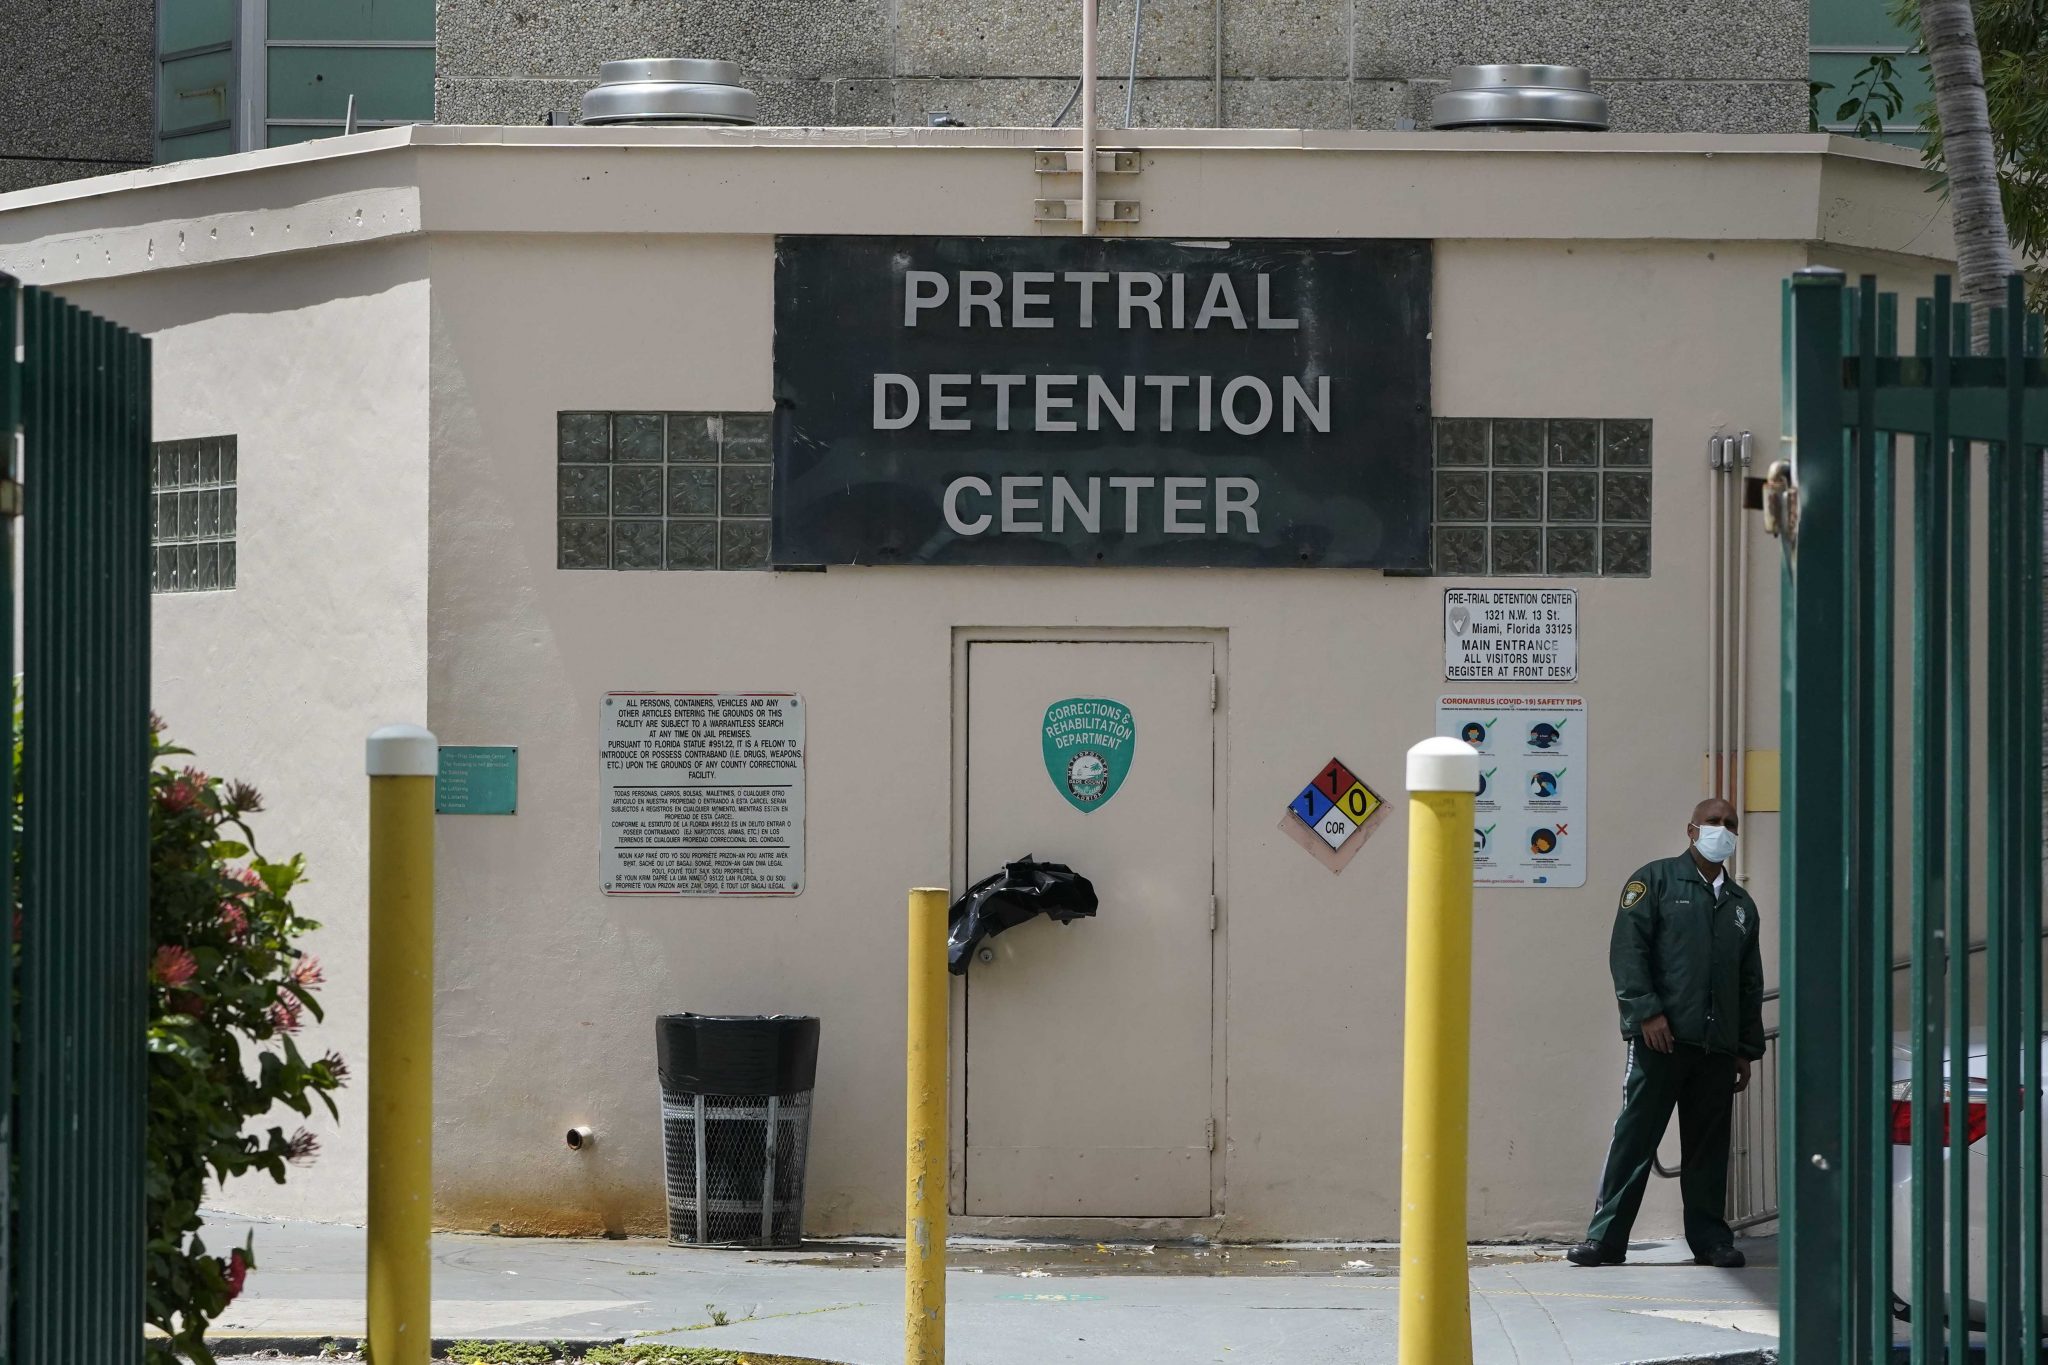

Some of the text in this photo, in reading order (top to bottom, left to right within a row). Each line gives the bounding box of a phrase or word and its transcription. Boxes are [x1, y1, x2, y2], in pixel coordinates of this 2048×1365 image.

[904, 271, 1299, 329] PRETRIAL
[873, 373, 1331, 435] DETENTION
[943, 475, 1260, 536] CENTER
[1448, 593, 1572, 604] PRE-TRIAL DETENTION CENTER
[1485, 610, 1560, 620] 1321 N.W. 13 St.
[1472, 623, 1572, 636] Miami, Florida 33125
[1462, 640, 1558, 651] MAIN ENTRANCE
[1464, 654, 1557, 664] ALL VISITORS MUST
[1448, 666, 1572, 677] REGISTER AT FRONT DESK
[626, 699, 638, 707] ALL
[640, 699, 672, 708] PERSONS,
[717, 699, 748, 707] VEHICLES
[750, 699, 764, 707] AND
[766, 699, 779, 707] ANY
[1496, 698, 1536, 706] (COVID-19)
[618, 709, 782, 717] OTHER ARTICLES ENTERING THE GROUNDS OR THIS
[1048, 703, 1130, 724] CORRECTIONS &
[616, 720, 784, 728] FACILITY ARE SUBJECT TO A WARRANTLESS SEARCH
[1046, 718, 1132, 740] REHABILITATION
[649, 730, 656, 738] AT
[659, 730, 672, 738] ANY
[674, 730, 689, 738] TIME
[691, 730, 701, 738] ON
[703, 730, 716, 738] JAIL
[608, 740, 641, 748] PURSUANT
[644, 740, 652, 748] TO
[654, 740, 681, 748] FLORIDA
[683, 740, 706, 748] STATUE
[737, 740, 743, 748] IT
[745, 740, 752, 748] IS
[754, 740, 759, 748] A
[761, 740, 786, 748] FELONY
[788, 740, 797, 748] TO
[1055, 732, 1122, 750] DEPARTMENT
[640, 750, 650, 758] OR
[652, 750, 682, 758] POSSESS
[684, 750, 728, 758] CONTRABAND
[626, 761, 644, 769] UPON
[646, 761, 658, 769] THE
[660, 761, 692, 769] GROUNDS
[694, 761, 703, 769] OF
[705, 760, 718, 769] ANY
[720, 760, 747, 768] COUNTY
[749, 760, 797, 768] CORRECTIONAL
[1327, 768, 1337, 795] 1
[1304, 790, 1314, 816] 1
[1349, 789, 1366, 816] 0
[1326, 822, 1344, 834] COR
